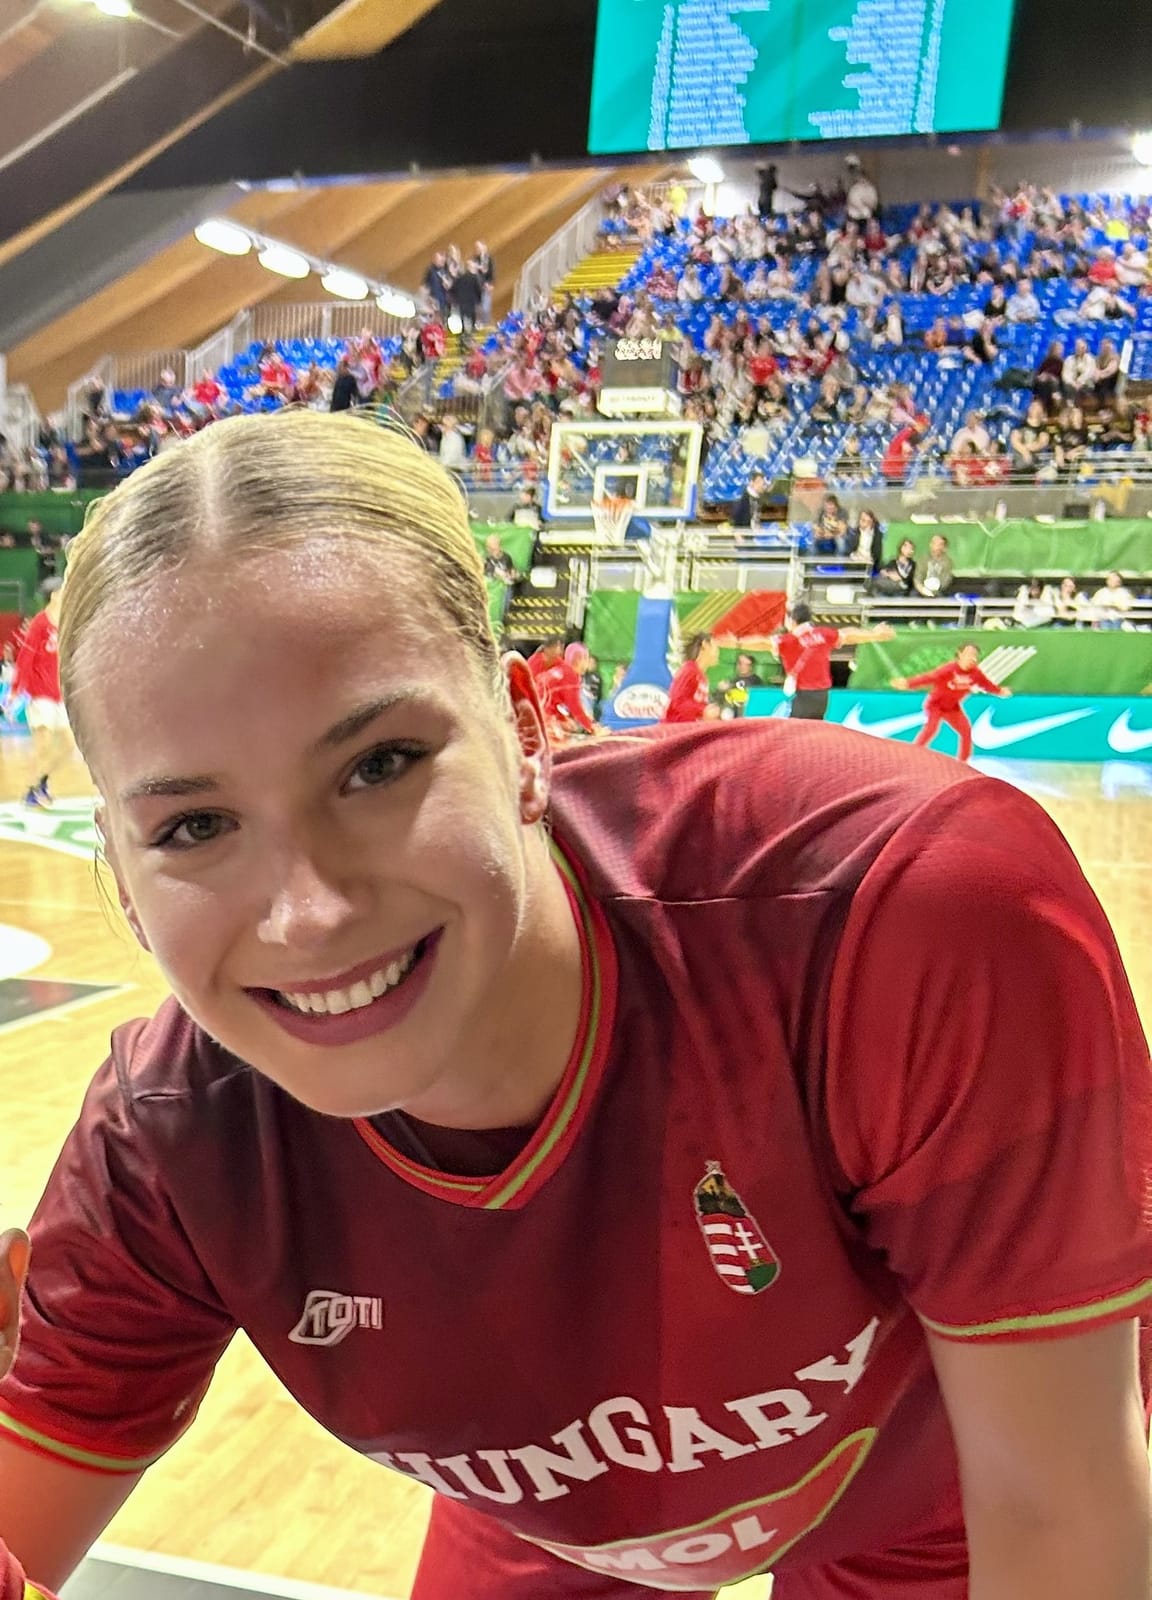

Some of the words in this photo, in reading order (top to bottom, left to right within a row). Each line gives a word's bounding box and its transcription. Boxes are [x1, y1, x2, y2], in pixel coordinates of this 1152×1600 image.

[305, 1295, 384, 1337] TOTI
[371, 1317, 879, 1504] HUNGARY
[585, 1515, 778, 1571] MOL
